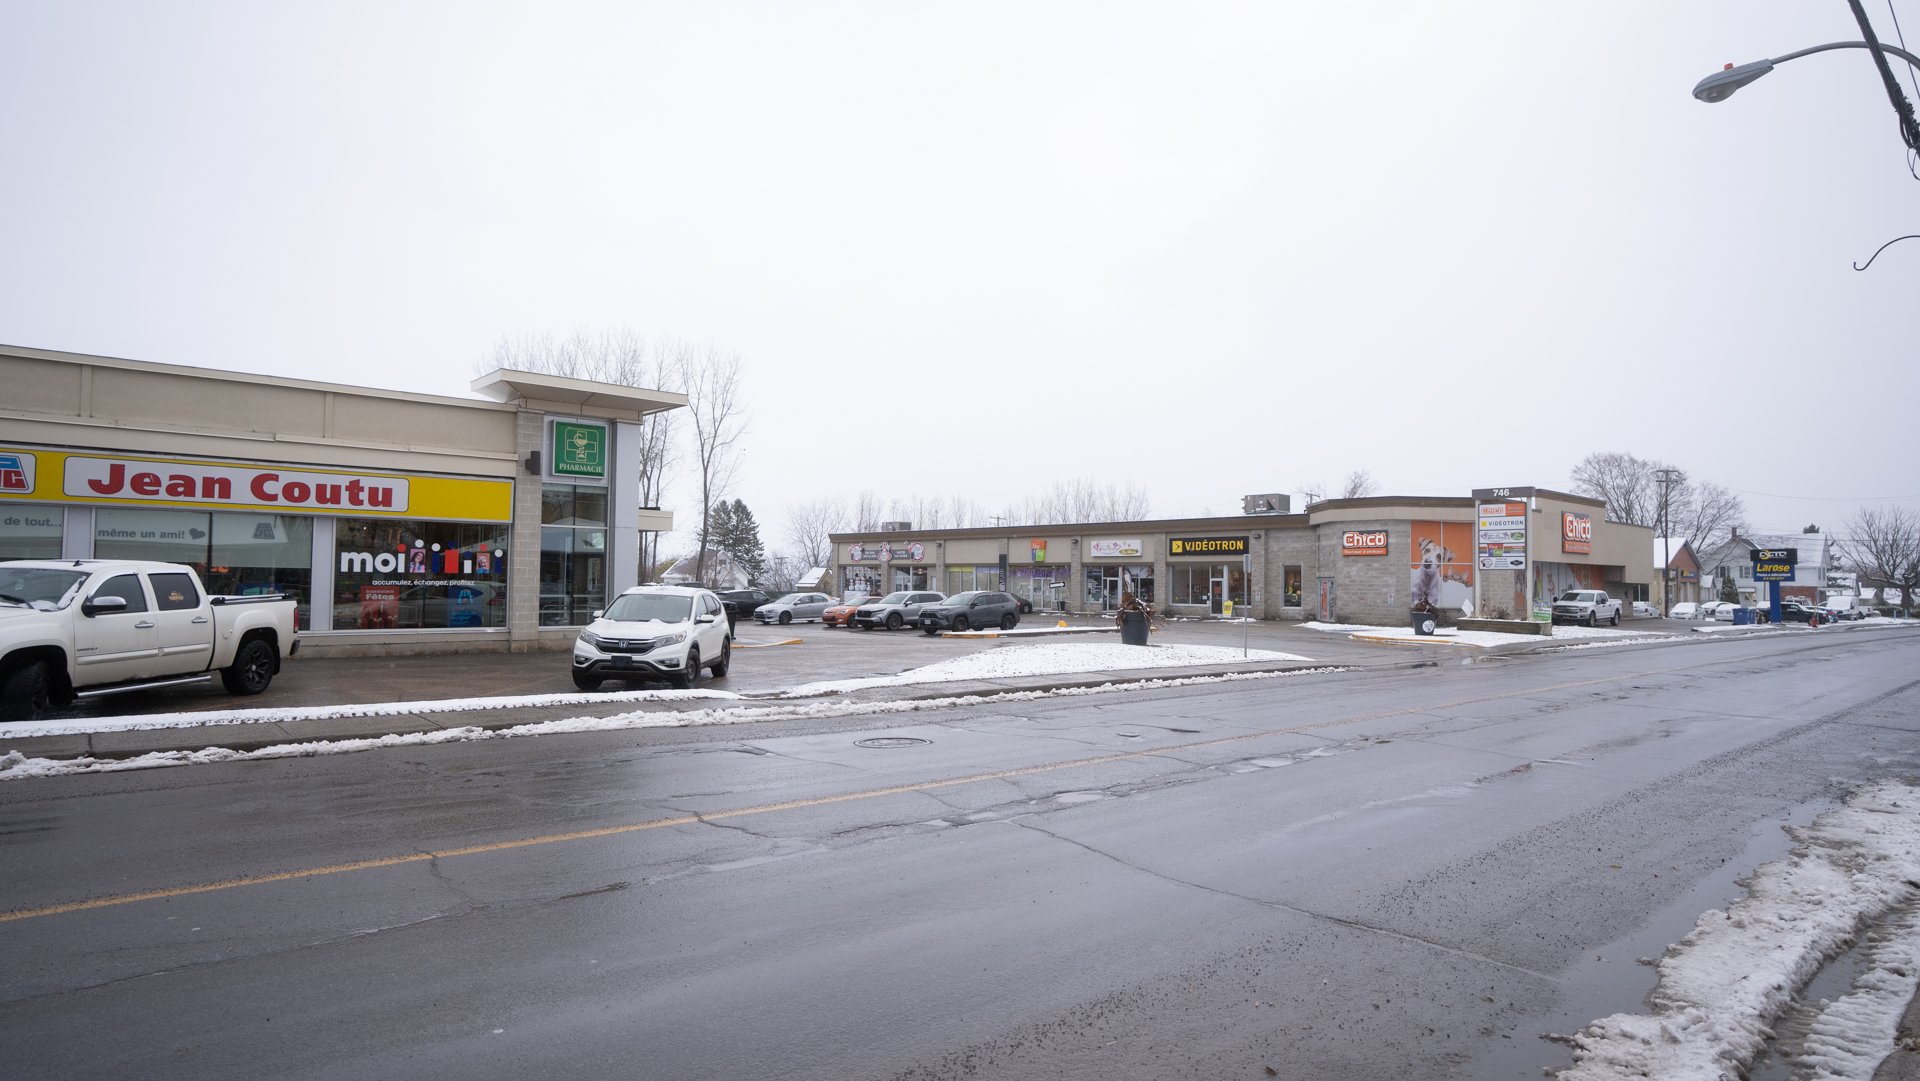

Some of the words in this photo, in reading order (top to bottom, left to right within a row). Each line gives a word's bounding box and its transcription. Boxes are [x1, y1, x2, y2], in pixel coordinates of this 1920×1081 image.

[560, 463, 602, 473] PHARMACIE
[87, 463, 232, 499] Jean
[250, 473, 393, 507] Coutu
[4, 516, 20, 526] de
[25, 517, 62, 527] tout...
[98, 528, 137, 538] même
[141, 530, 156, 539] un
[159, 530, 185, 539] ami!
[1184, 539, 1244, 551] VIDÉOTRON
[1343, 532, 1386, 547] Chico
[340, 543, 407, 573] moi
[1756, 563, 1790, 573] Larose
[372, 579, 413, 587] accumulez,
[413, 578, 449, 588] échangez,
[449, 579, 475, 588] profitez
